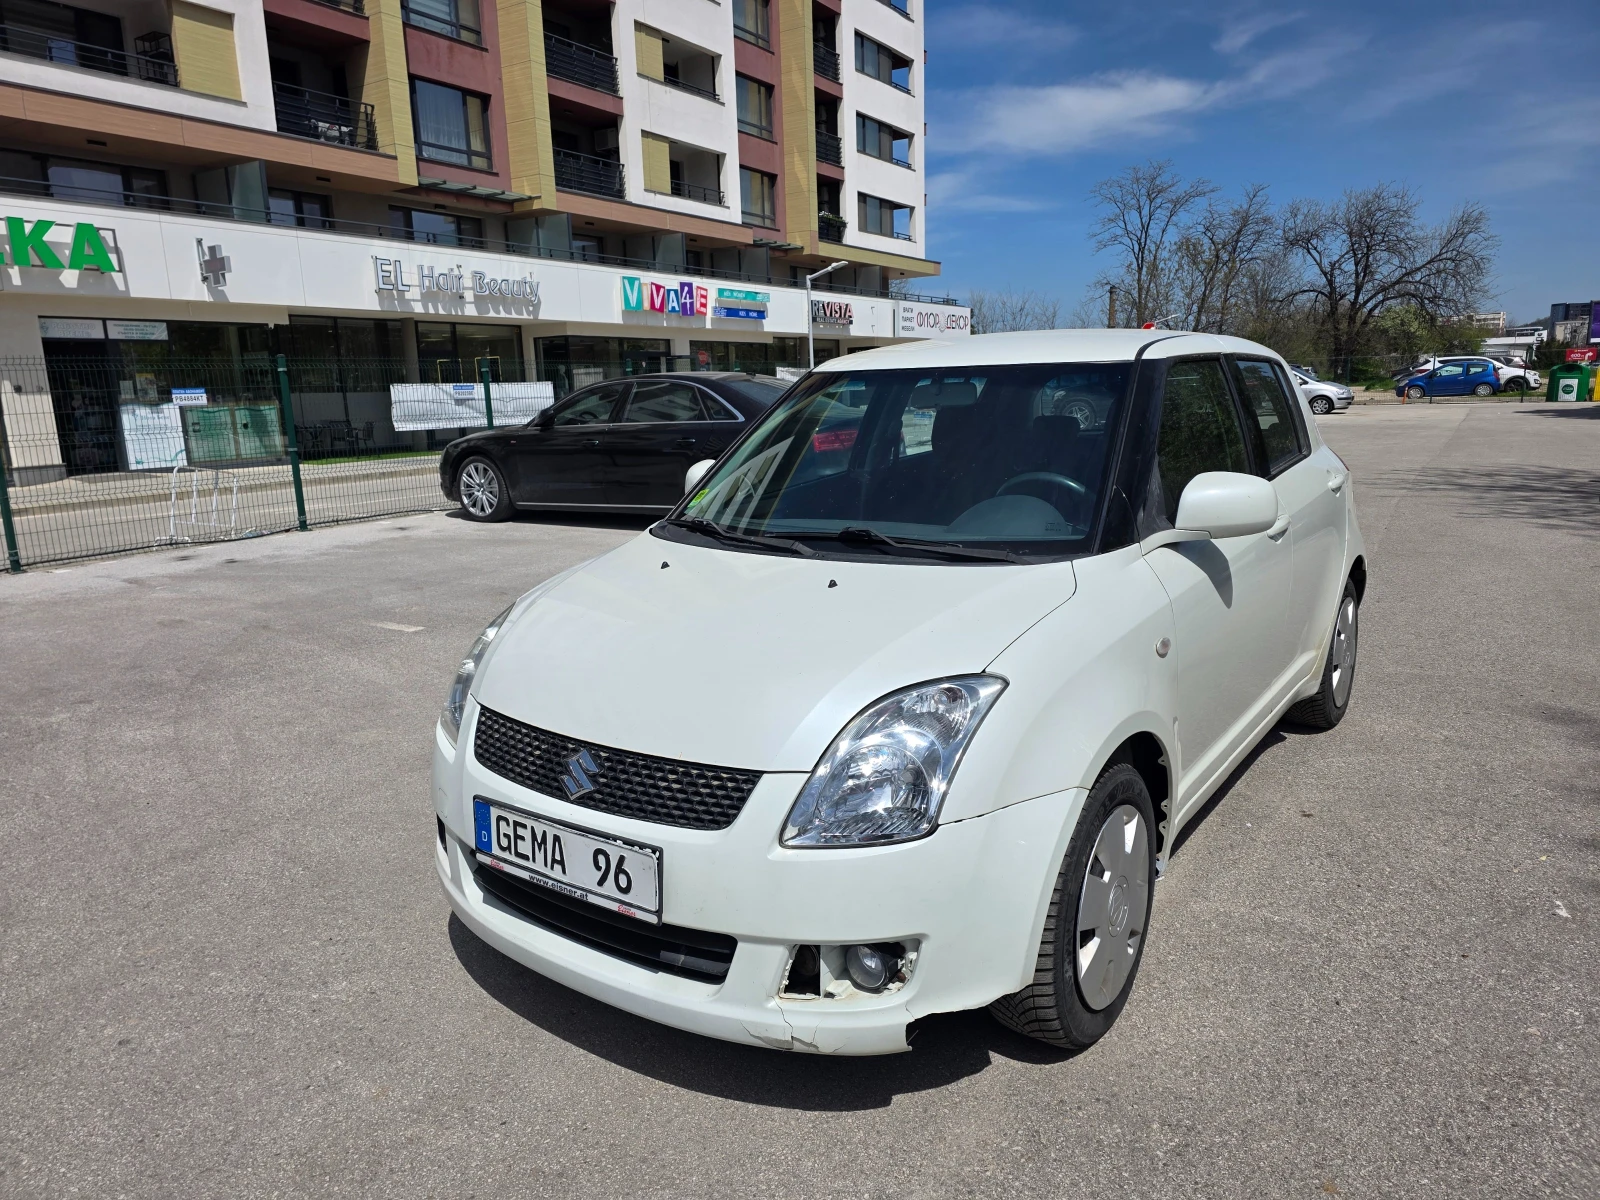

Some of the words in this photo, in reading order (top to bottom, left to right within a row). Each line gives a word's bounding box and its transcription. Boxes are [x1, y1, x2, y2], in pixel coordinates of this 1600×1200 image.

[0, 216, 116, 272] КА
[375, 256, 410, 292] EL
[418, 264, 464, 292] Hair
[472, 270, 540, 304] Beauty
[811, 300, 854, 318] REVISTA
[481, 831, 488, 842] D
[495, 814, 568, 876] GEMA
[592, 847, 634, 895] 96
[528, 874, 589, 901] www.eisner.at
